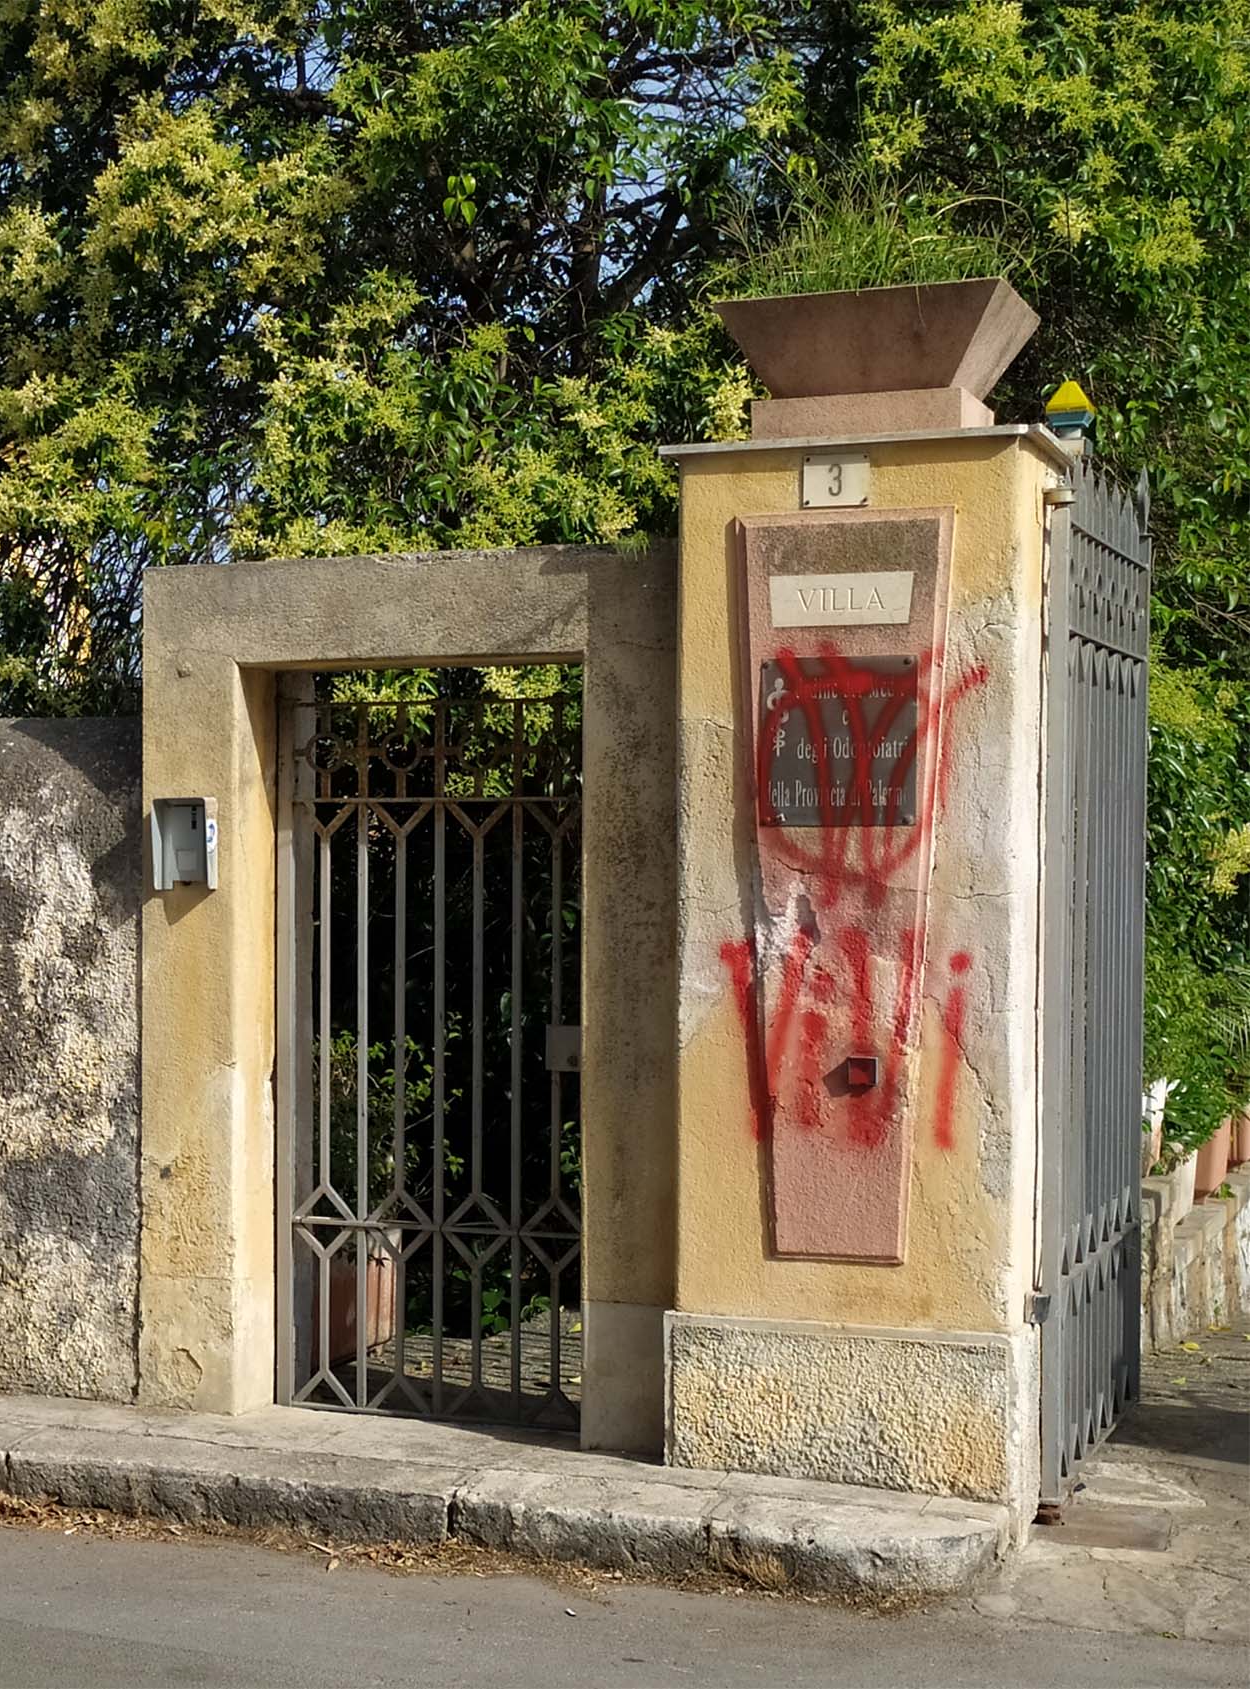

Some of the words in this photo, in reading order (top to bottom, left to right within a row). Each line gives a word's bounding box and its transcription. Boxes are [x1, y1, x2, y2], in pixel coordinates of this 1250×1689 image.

[828, 463, 842, 496] 3
[796, 586, 887, 613] VILLA
[796, 736, 828, 764] degi
[833, 736, 909, 760] Odooiatr
[795, 778, 846, 807] Provcia
